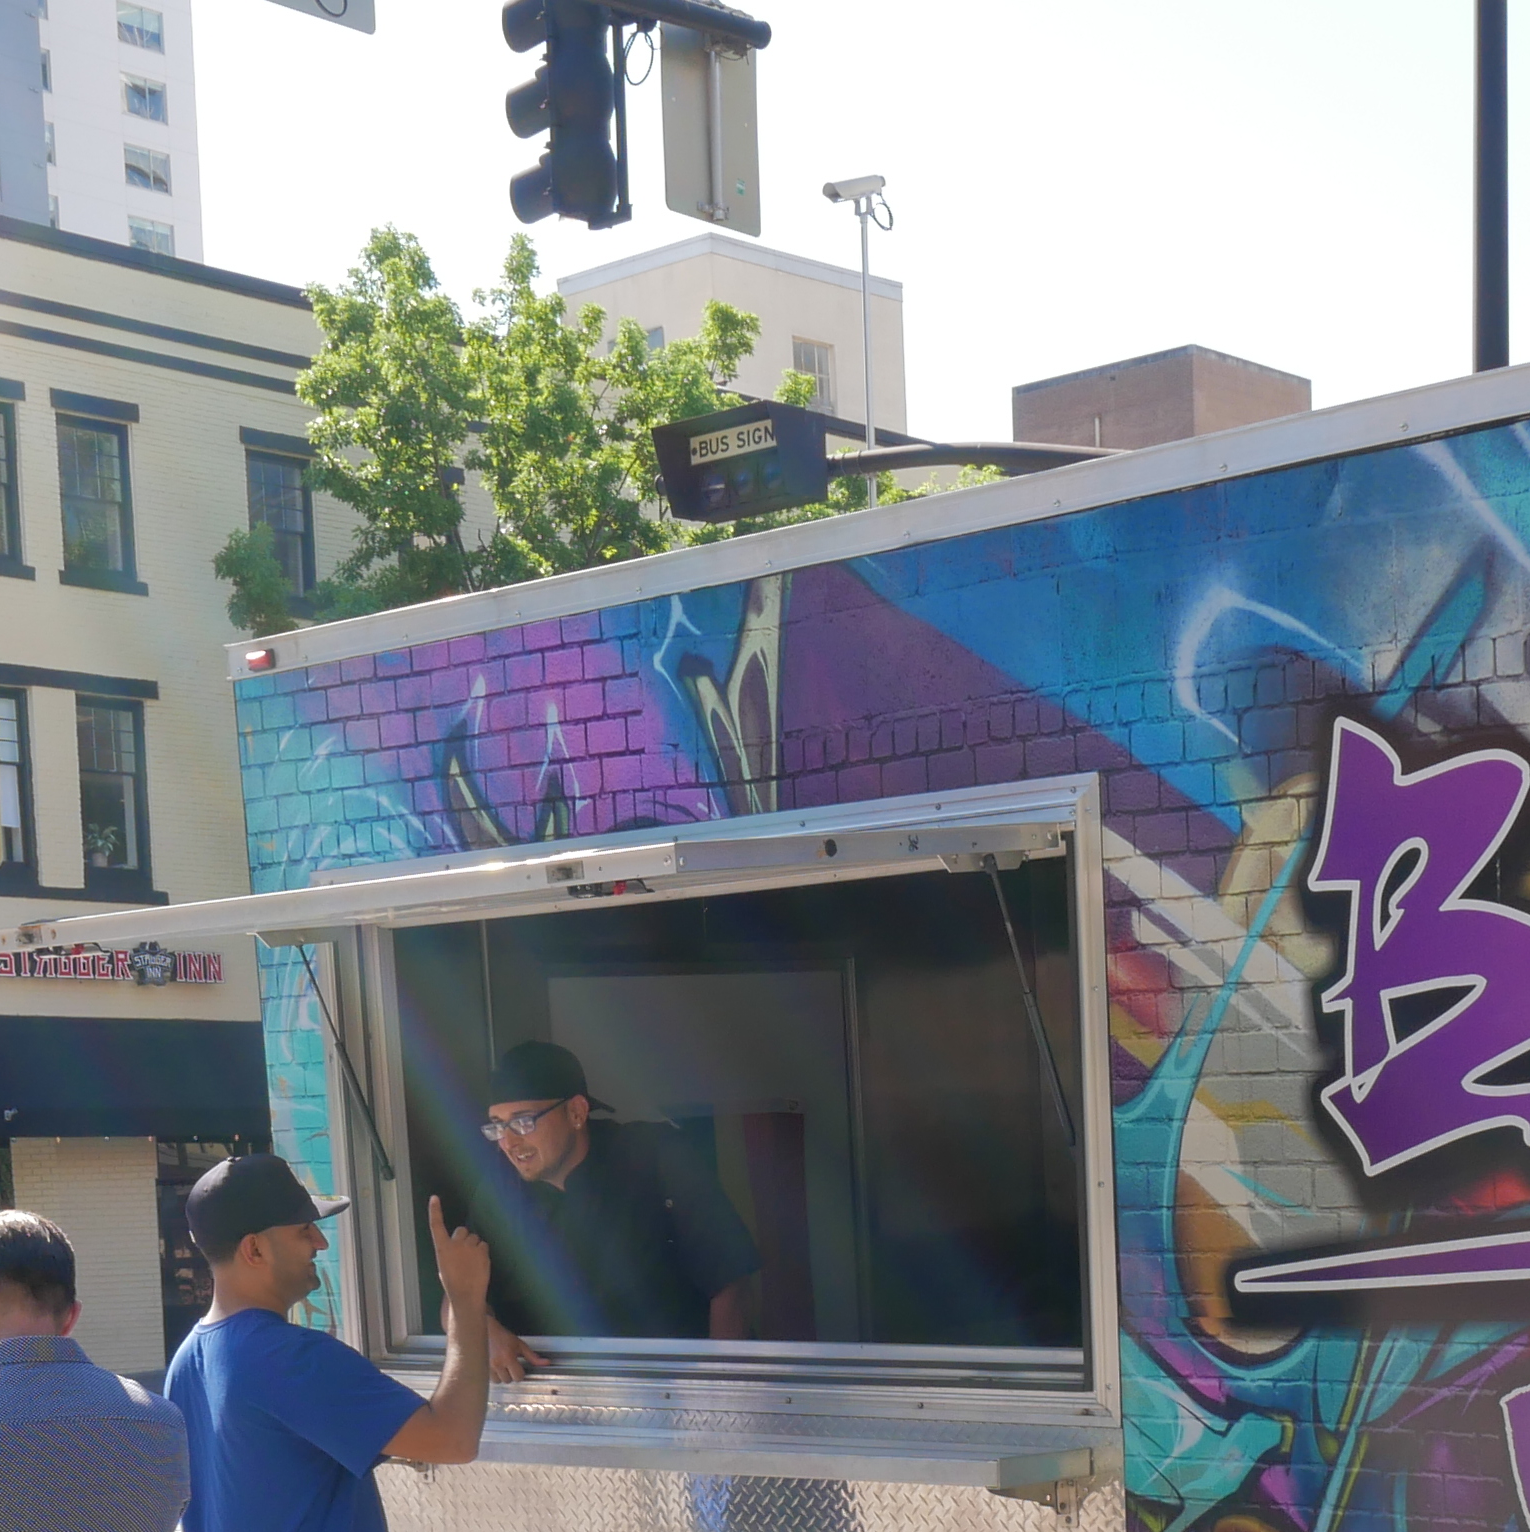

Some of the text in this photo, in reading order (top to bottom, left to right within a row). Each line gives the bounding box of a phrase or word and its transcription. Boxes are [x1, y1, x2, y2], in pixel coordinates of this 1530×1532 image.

[698, 425, 775, 458] BUS SIGN
[146, 965, 161, 978] INN
[175, 951, 225, 983] INN
